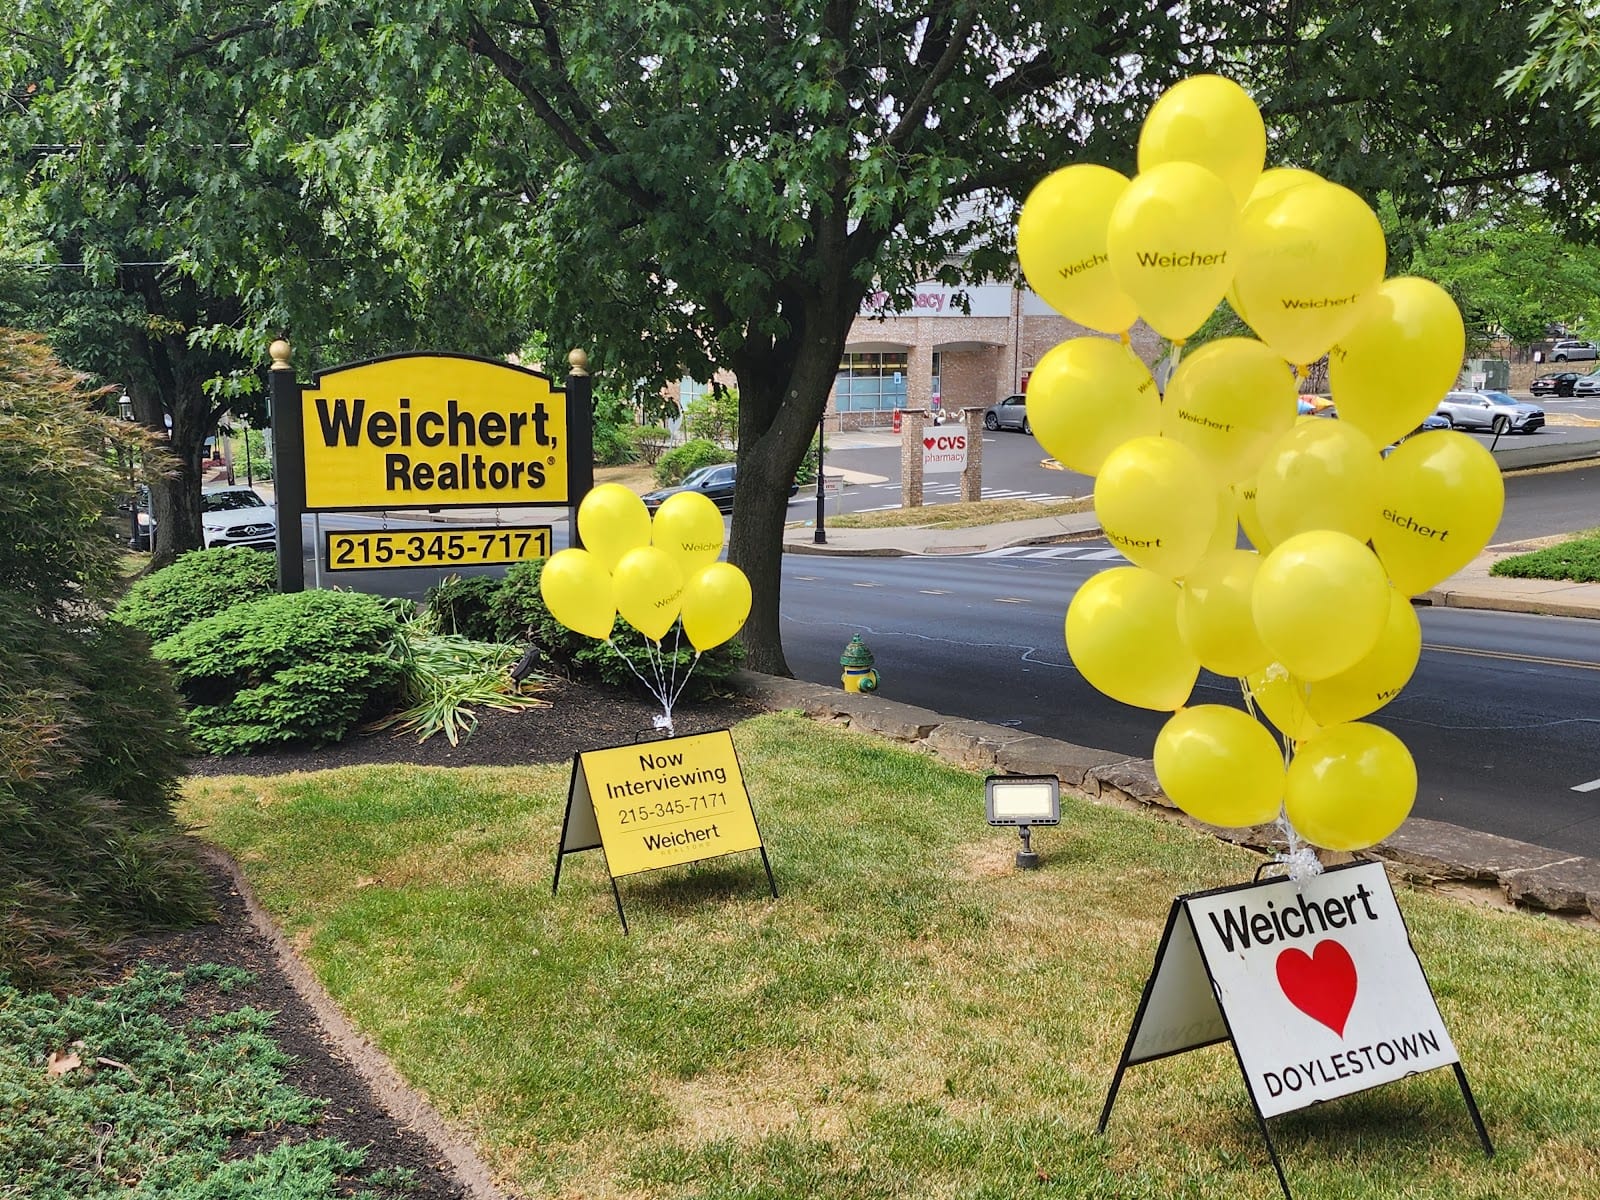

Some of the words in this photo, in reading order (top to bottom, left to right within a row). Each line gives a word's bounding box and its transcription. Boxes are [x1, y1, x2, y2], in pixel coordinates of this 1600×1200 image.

[1136, 250, 1227, 268] Weichert
[1281, 294, 1356, 310] Weichert
[315, 398, 558, 450] Weichert,
[1178, 409, 1231, 432] Weichert
[924, 452, 966, 464] pharmacy
[937, 436, 966, 450] CVS
[1382, 508, 1449, 542] eichert
[336, 531, 546, 564] 215-345-7171
[639, 752, 684, 771] Now
[606, 766, 727, 800] Interviewing
[618, 792, 727, 825] 215-345-7171
[643, 824, 720, 851] Weichert
[1209, 884, 1377, 953] Weichert
[1262, 1029, 1441, 1098] DOYLESTOWN
